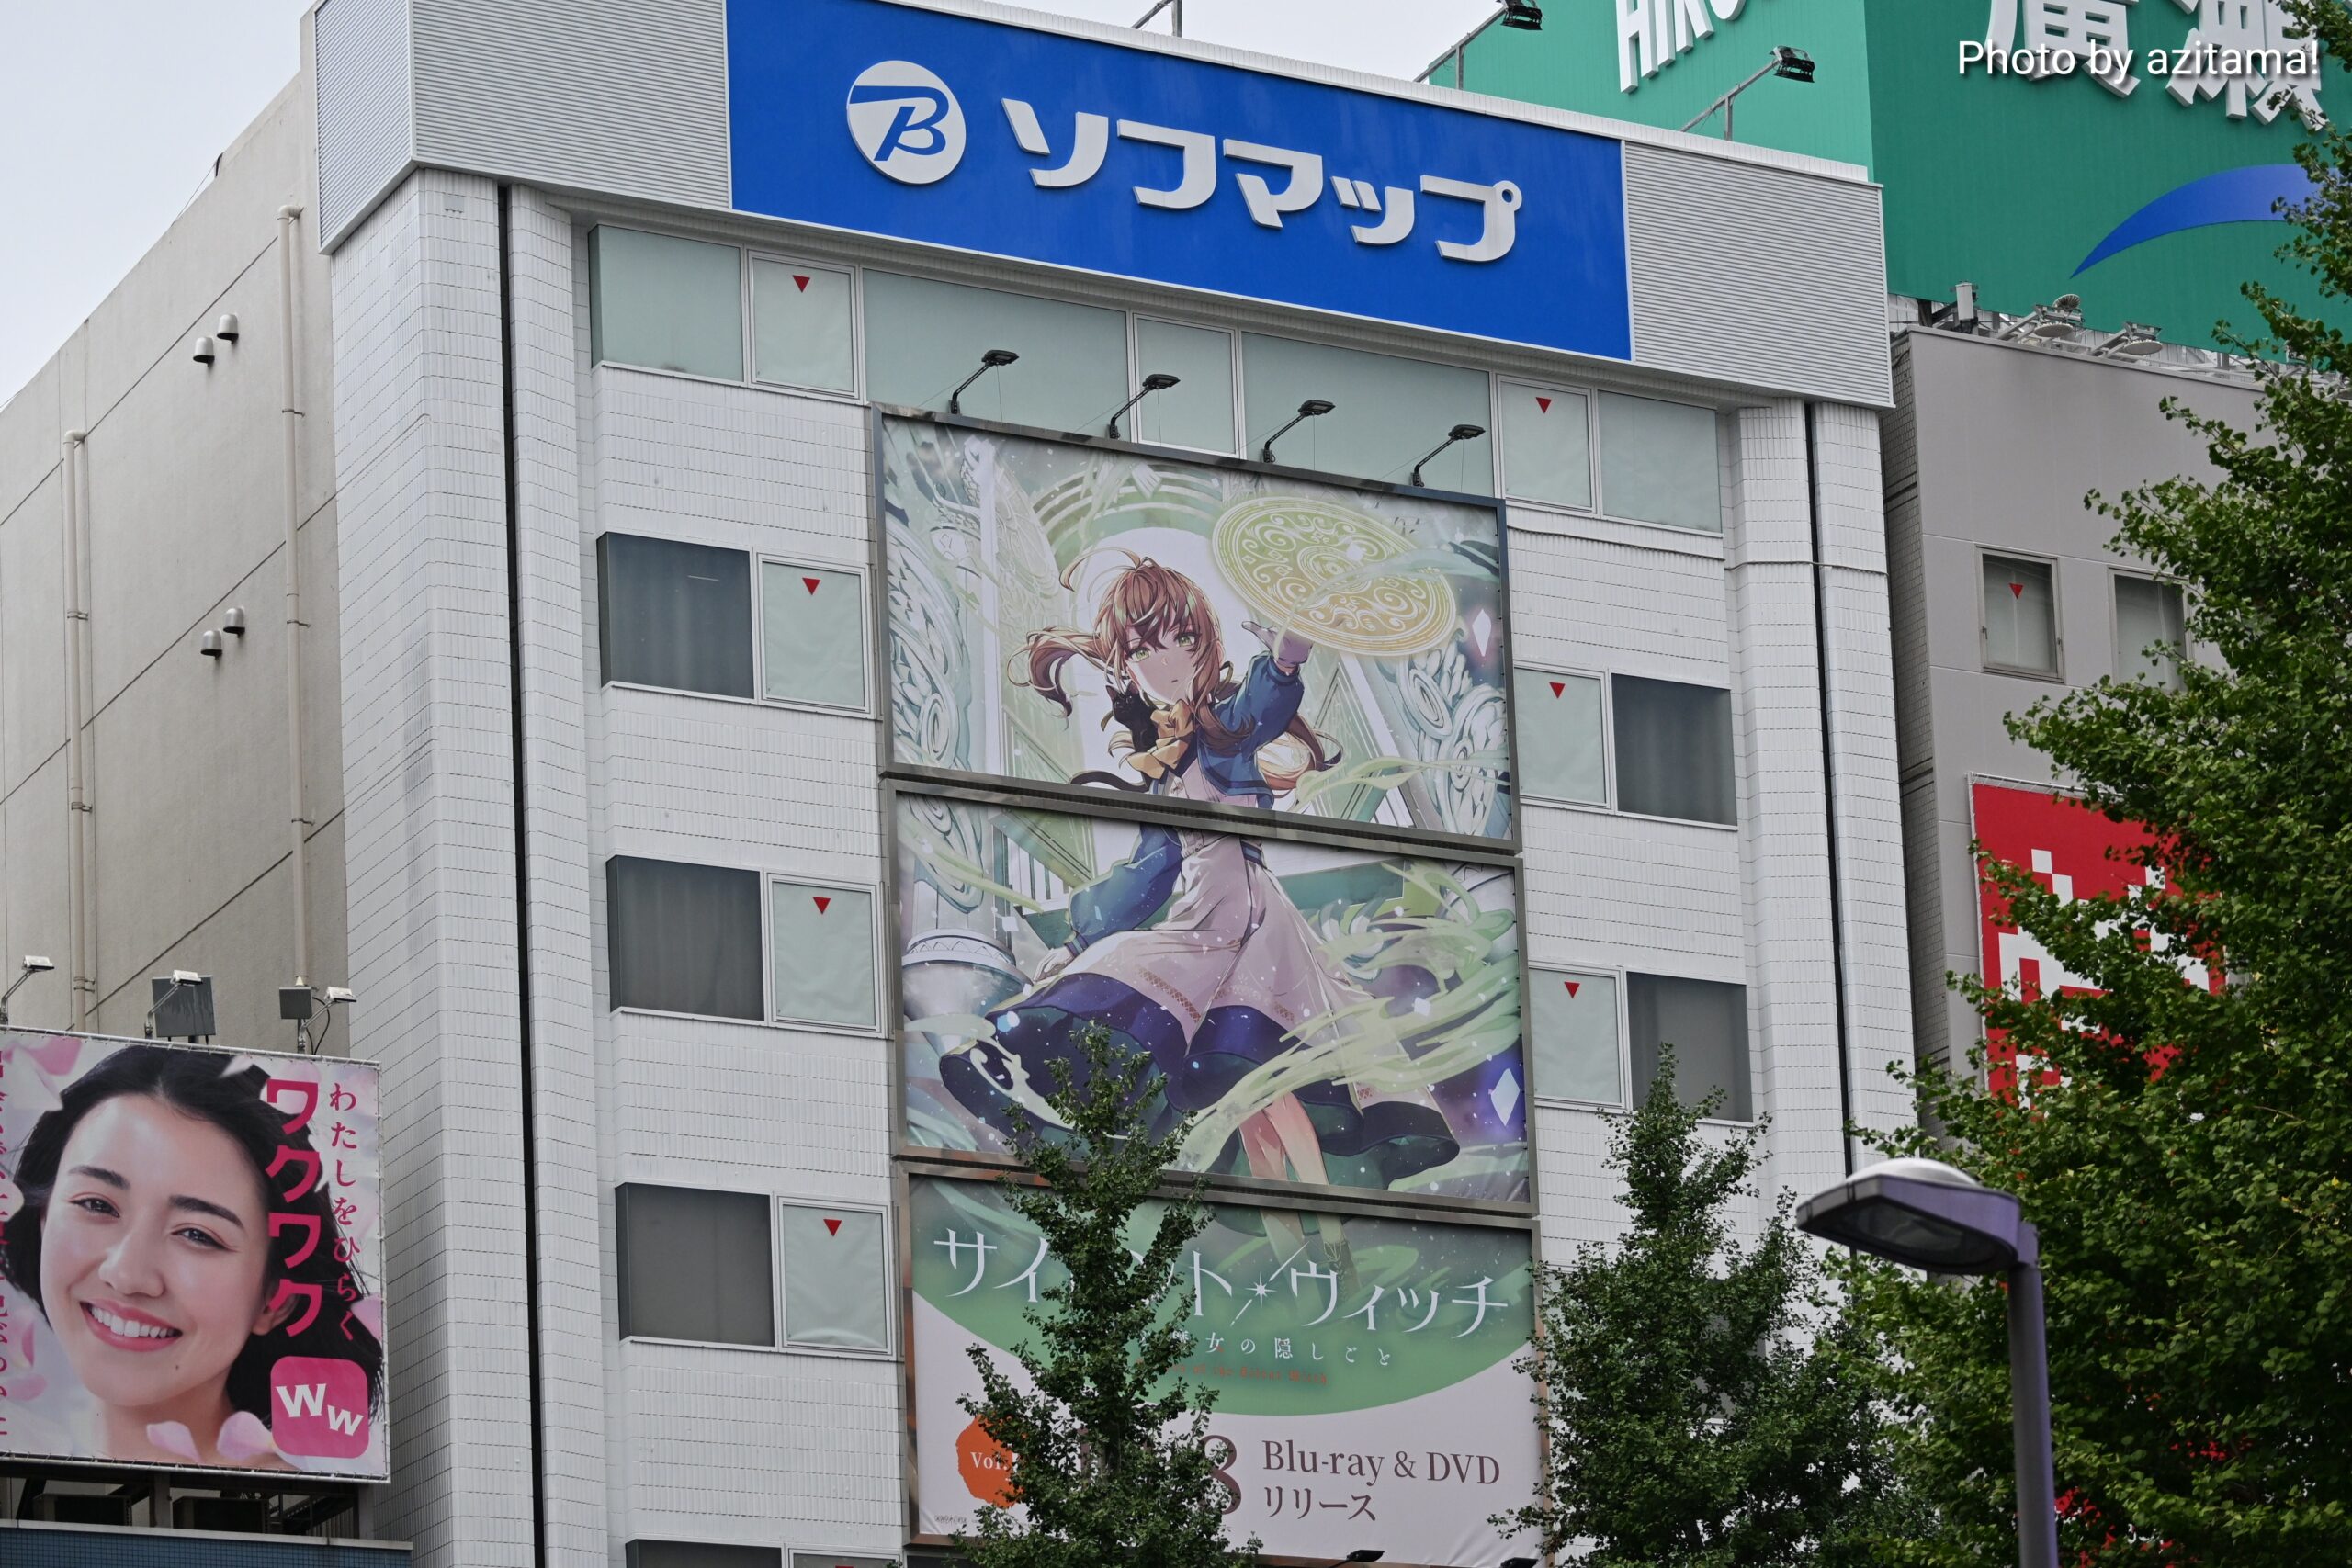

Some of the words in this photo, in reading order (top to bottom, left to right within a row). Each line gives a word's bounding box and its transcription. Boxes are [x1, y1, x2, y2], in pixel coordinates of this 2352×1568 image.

[1001, 97, 1522, 263] ソフマップ
[265, 1077, 322, 1337] ワクワク
[330, 1082, 364, 1342] わたしをひらく
[1261, 1439, 1385, 1487] Blu-ray
[1393, 1450, 1418, 1479] &
[1425, 1451, 1501, 1485] DVD
[1263, 1485, 1376, 1522] リリース
